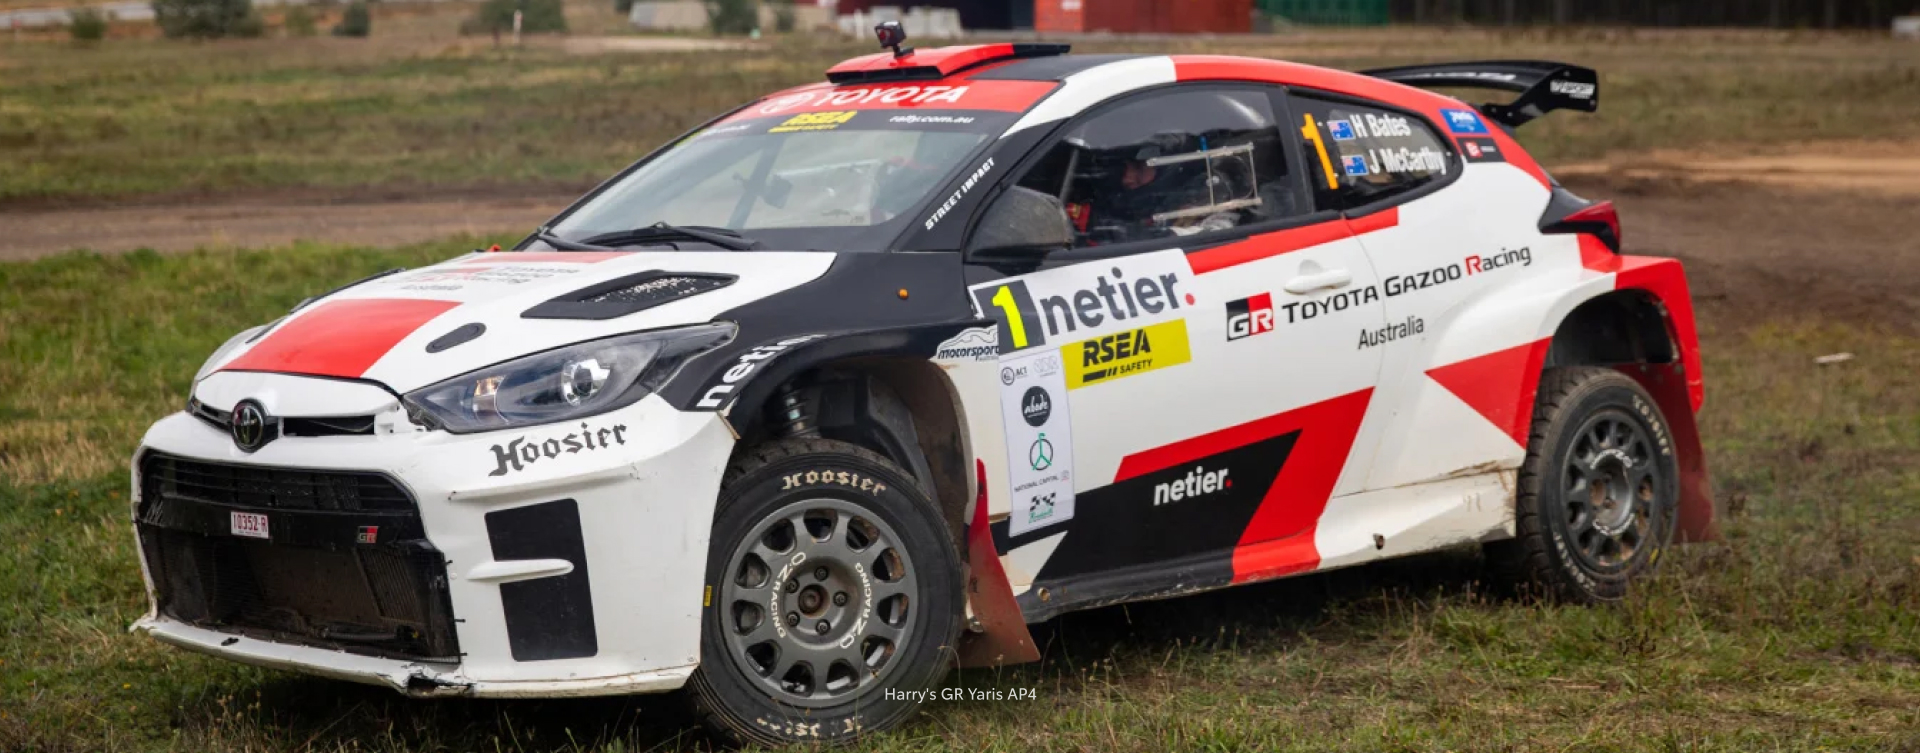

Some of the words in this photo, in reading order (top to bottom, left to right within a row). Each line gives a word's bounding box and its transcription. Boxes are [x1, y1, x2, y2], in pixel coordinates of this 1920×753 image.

[813, 85, 969, 107] TOYOTA
[888, 113, 975, 124] rally.com.au
[1351, 114, 1368, 139] H
[1368, 113, 1413, 138] Bates
[1300, 112, 1338, 190] 1
[1368, 149, 1382, 175] J
[1382, 145, 1447, 175] McCarthy
[924, 190, 963, 231] STREET
[961, 157, 996, 195] IMPACT
[1228, 307, 1274, 341] GR
[1281, 283, 1380, 324] TOYOTA
[1384, 263, 1462, 298] GAZOO
[1465, 246, 1532, 276] Racing
[992, 284, 1029, 349] 1
[1357, 315, 1425, 350] Australia
[1082, 328, 1152, 368] RSEA
[1119, 359, 1153, 375] SAFETY
[488, 421, 627, 477] Hoosier
[781, 469, 887, 497] Hoosier
[1014, 481, 1038, 492] NATIONAL
[1039, 475, 1060, 485] CAPITAL
[855, 562, 873, 619] RACING
[770, 581, 787, 638] RACING
